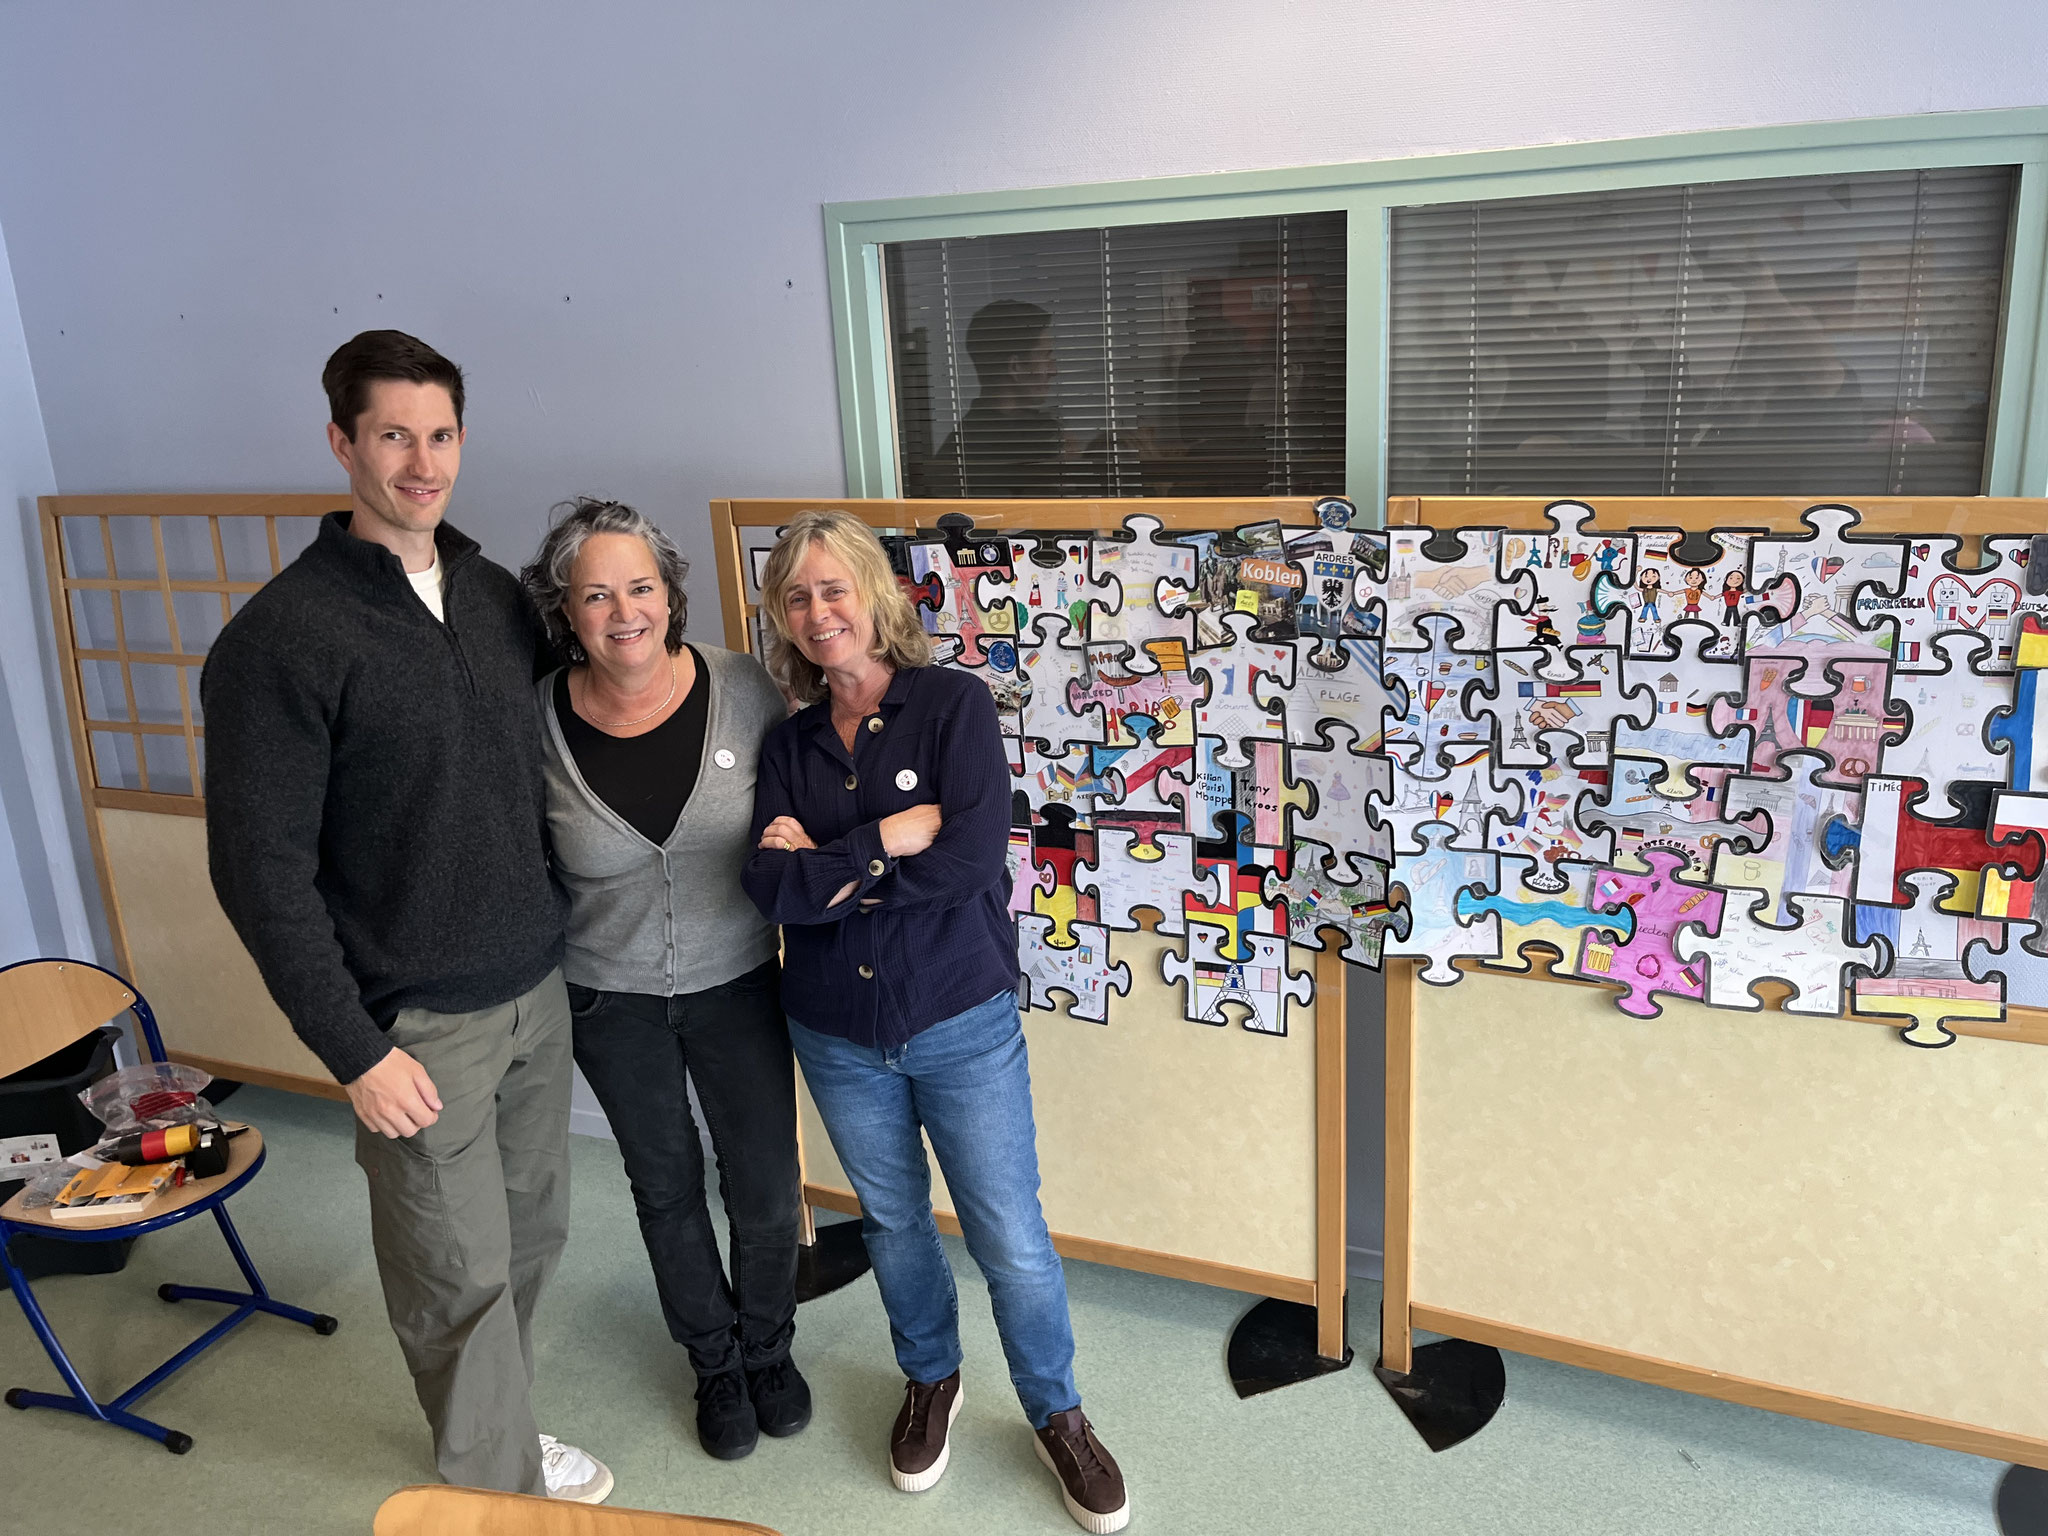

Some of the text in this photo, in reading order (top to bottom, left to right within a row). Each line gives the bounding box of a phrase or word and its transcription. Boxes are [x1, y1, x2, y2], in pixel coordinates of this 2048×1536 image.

[1315, 552, 1354, 565] ARDRES
[1242, 562, 1302, 585] Koblen
[1296, 667, 1335, 681] ALAIS
[1072, 689, 1113, 701] WALEED
[1320, 689, 1361, 703] PLAGE
[1196, 772, 1222, 782] Kilian
[1199, 781, 1225, 793] (Paris)
[1240, 779, 1271, 796] Tony
[1244, 798, 1279, 812] Kroos
